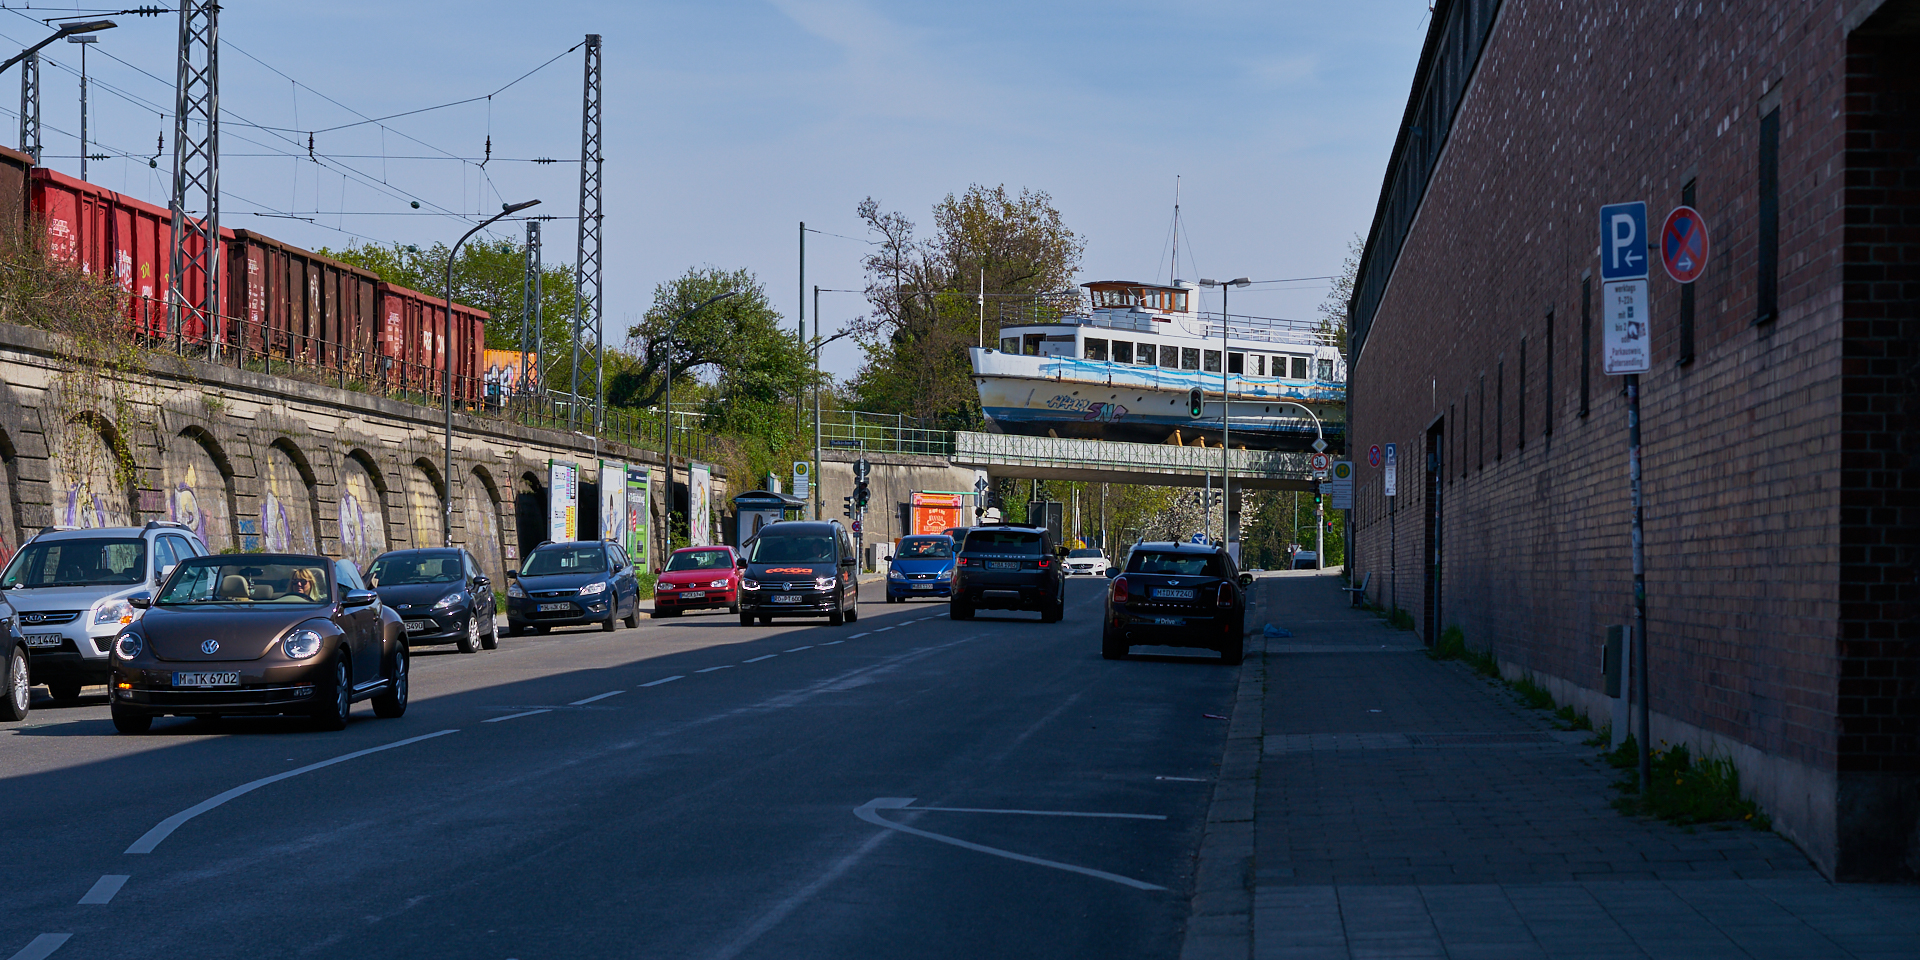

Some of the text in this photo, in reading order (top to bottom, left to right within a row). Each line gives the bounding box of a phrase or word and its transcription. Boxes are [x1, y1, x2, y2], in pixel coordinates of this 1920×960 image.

[1611, 213, 1637, 269] P
[1615, 284, 1636, 294] werktags
[1618, 310, 1626, 319] mit
[1615, 322, 1623, 332] bis
[1612, 347, 1641, 356] Parkausweis
[1387, 446, 1394, 464] P
[1175, 589, 1193, 597] 7240
[37, 635, 60, 645] 1440
[179, 673, 237, 684] M TK 6702
